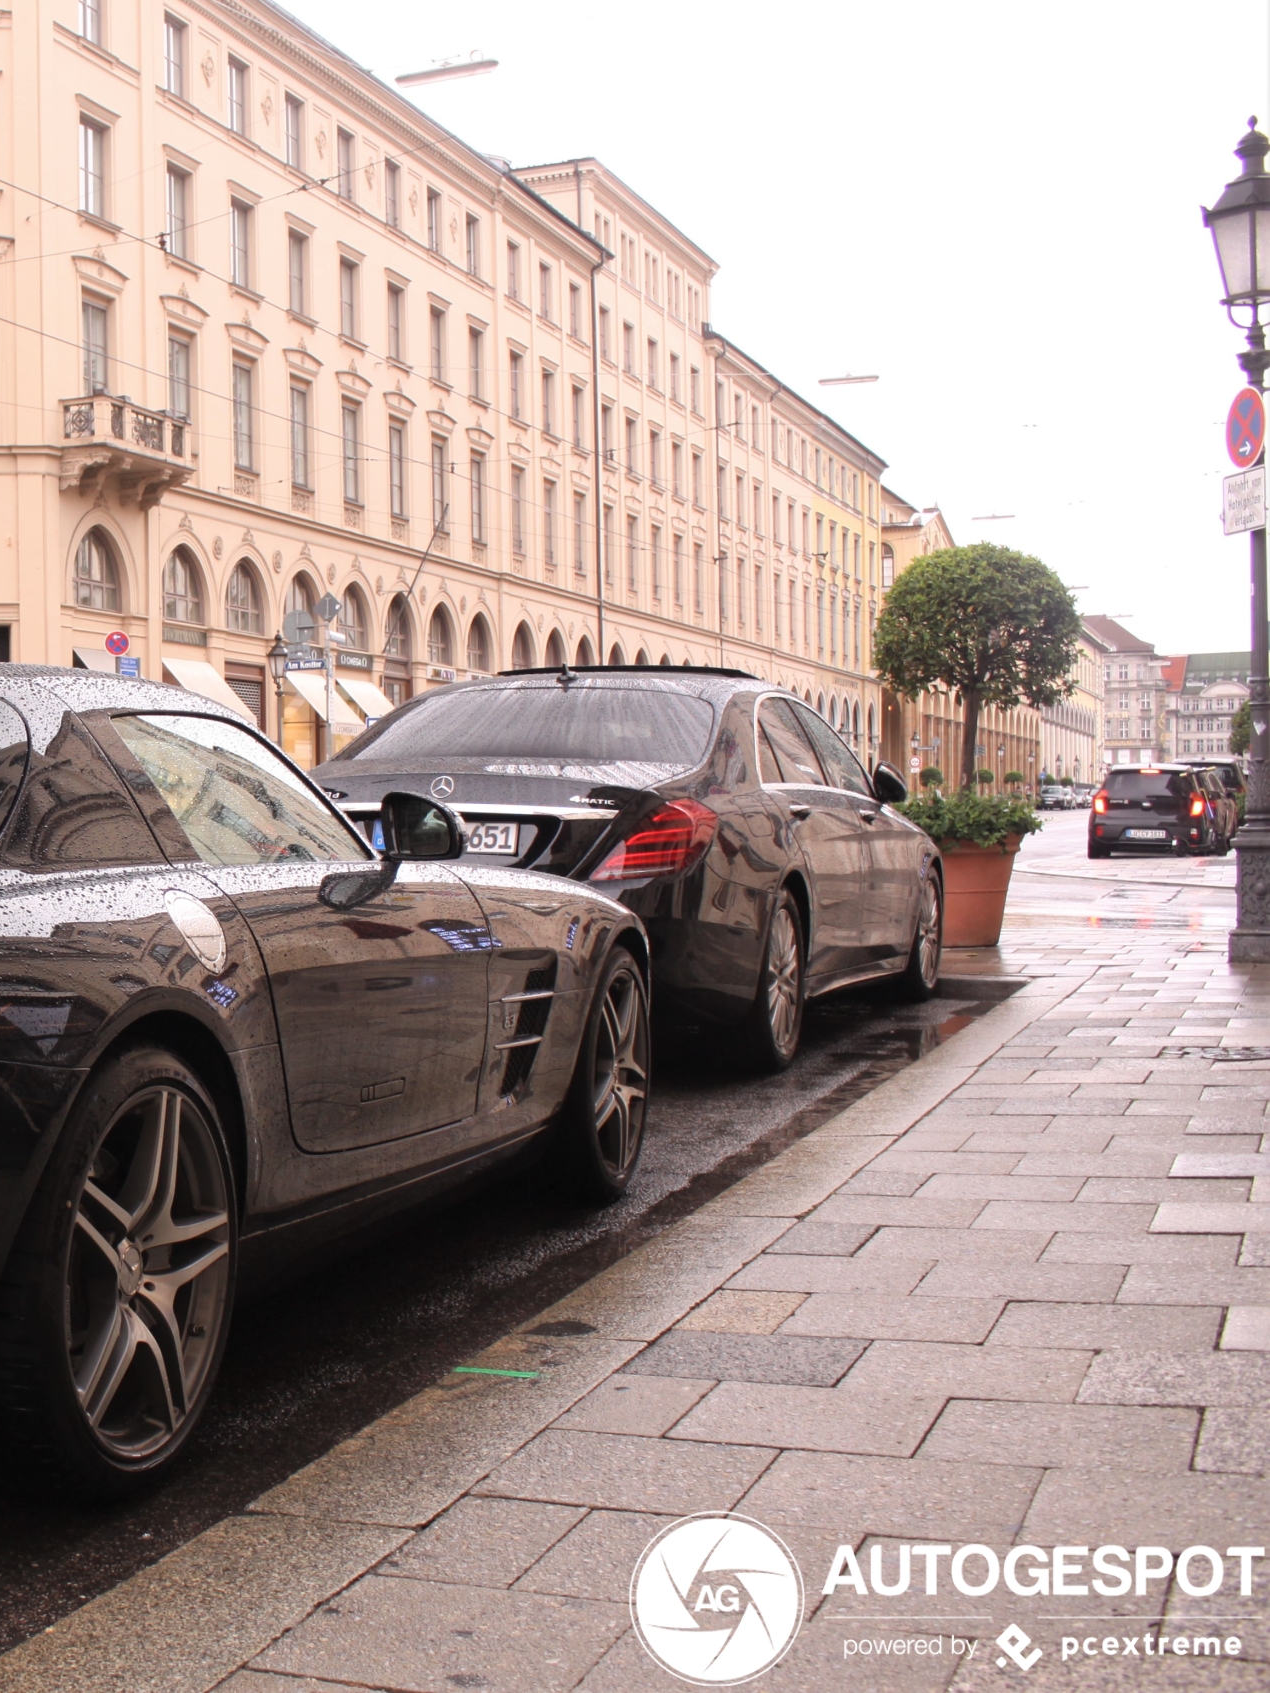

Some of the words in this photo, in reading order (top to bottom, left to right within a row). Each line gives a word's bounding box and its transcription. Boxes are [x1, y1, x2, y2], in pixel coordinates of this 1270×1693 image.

[287, 661, 299, 669] Am
[347, 657, 362, 667] OMEGA
[569, 795, 615, 806] 4MATIC
